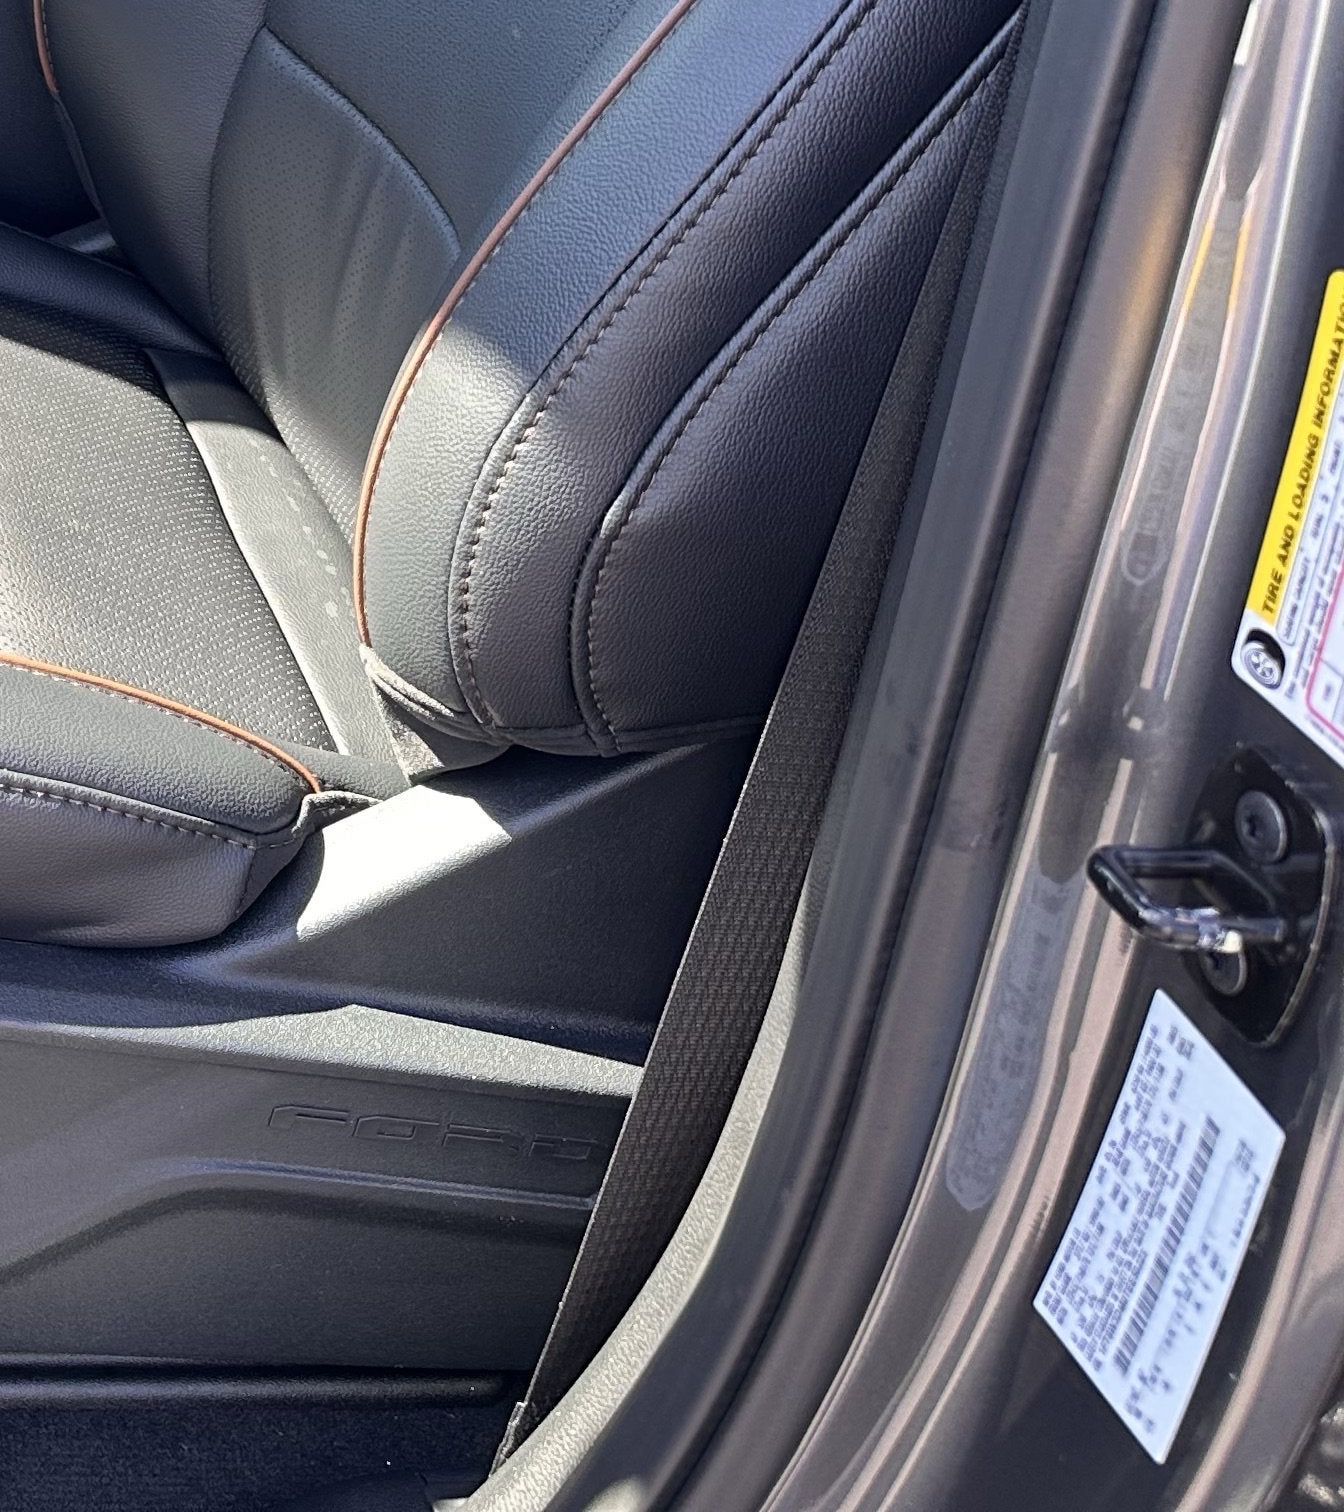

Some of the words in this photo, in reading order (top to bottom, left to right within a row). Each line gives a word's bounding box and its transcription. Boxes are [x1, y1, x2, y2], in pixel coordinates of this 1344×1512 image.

[1262, 567, 1282, 615] TIRE
[1277, 524, 1295, 568] AND
[1288, 432, 1320, 522] LOADING
